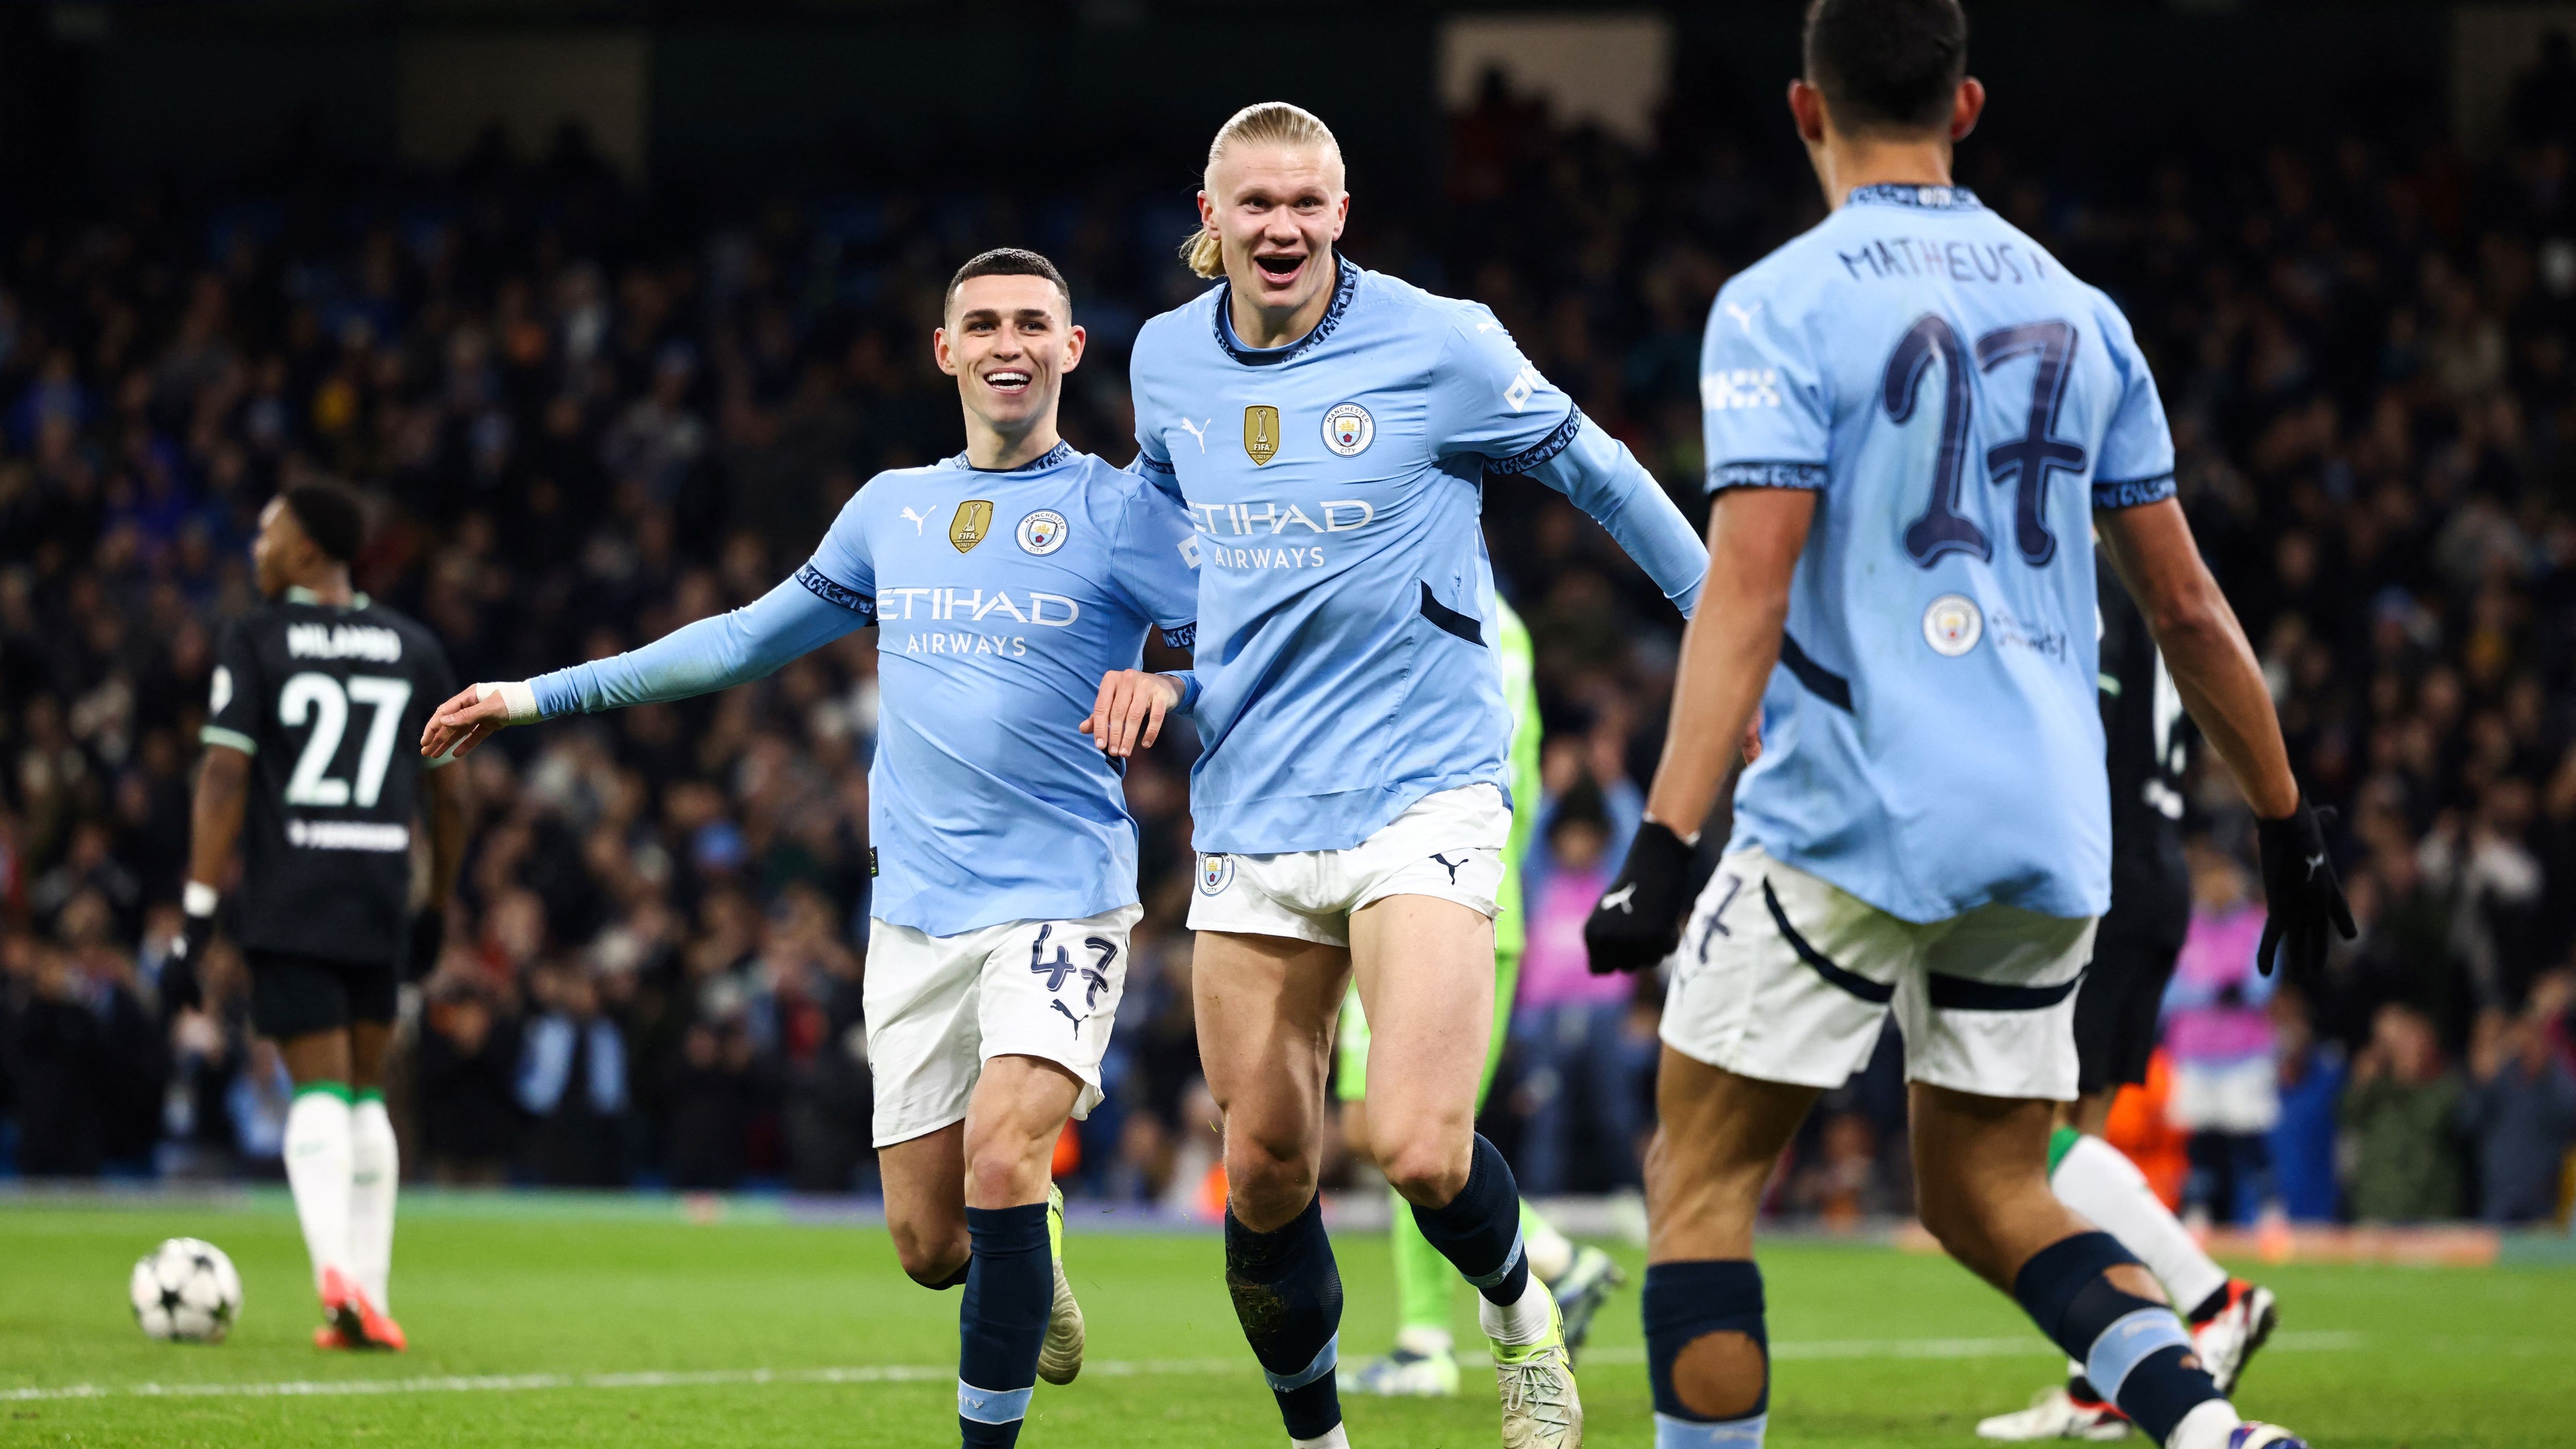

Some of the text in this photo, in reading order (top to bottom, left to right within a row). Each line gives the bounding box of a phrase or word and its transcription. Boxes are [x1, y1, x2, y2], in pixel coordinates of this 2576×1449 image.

[1837, 236, 2022, 284] MATHEUS
[1326, 406, 1370, 423] MANCHESTER
[1881, 312, 2087, 570] 27
[1025, 512, 1065, 530] MANCHESTER
[1215, 546, 1325, 569] AIRWAYS
[876, 588, 1080, 627] ETIHAD
[906, 632, 1027, 657] AIRWAYS
[279, 670, 412, 808] 27
[1030, 923, 1118, 1010] 47
[957, 1392, 983, 1410] ITY
